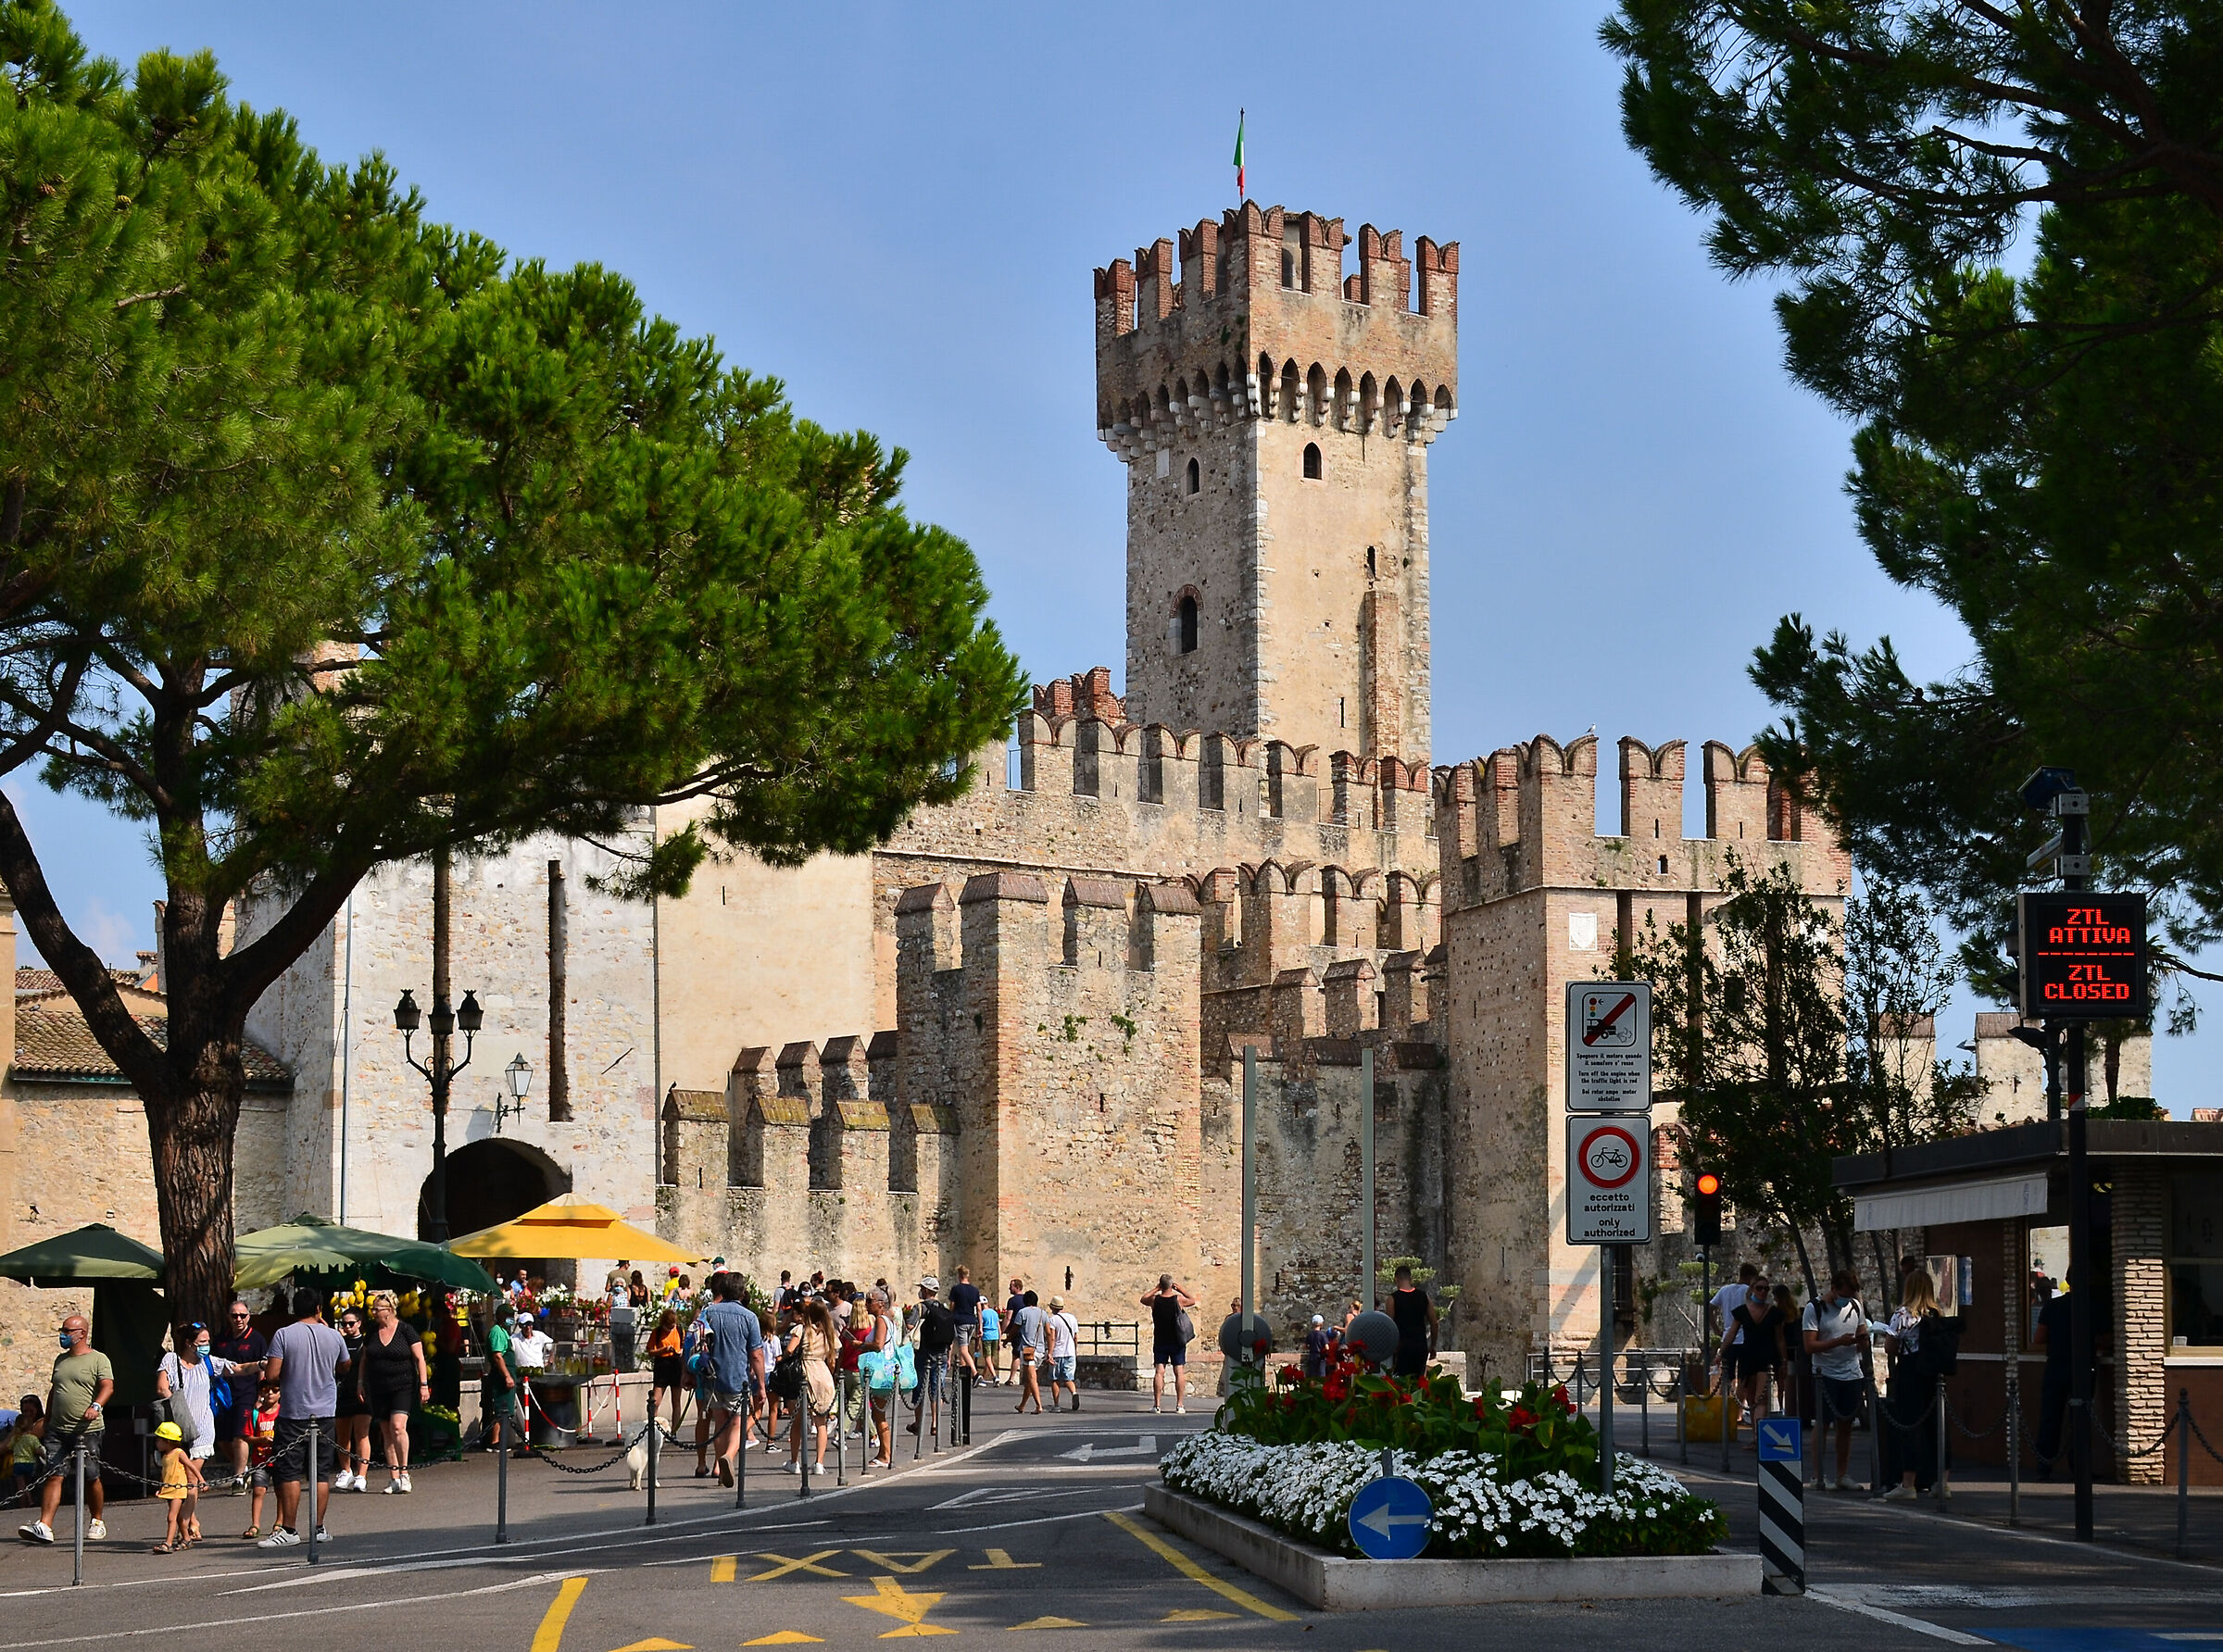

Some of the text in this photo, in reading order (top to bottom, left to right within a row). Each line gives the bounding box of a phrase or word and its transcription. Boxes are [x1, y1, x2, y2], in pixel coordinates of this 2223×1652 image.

[2067, 908, 2109, 925] ZTL
[2049, 928, 2130, 944] ATTIVA
[2068, 965, 2111, 981] ZTL
[2044, 983, 2129, 999] CLOSED
[1589, 1193, 1629, 1201] eccetto
[1584, 1203, 1636, 1212] autorizzati
[1599, 1217, 1620, 1228] only
[1584, 1228, 1636, 1237] authorized
[710, 1548, 1043, 1583] TAXI
